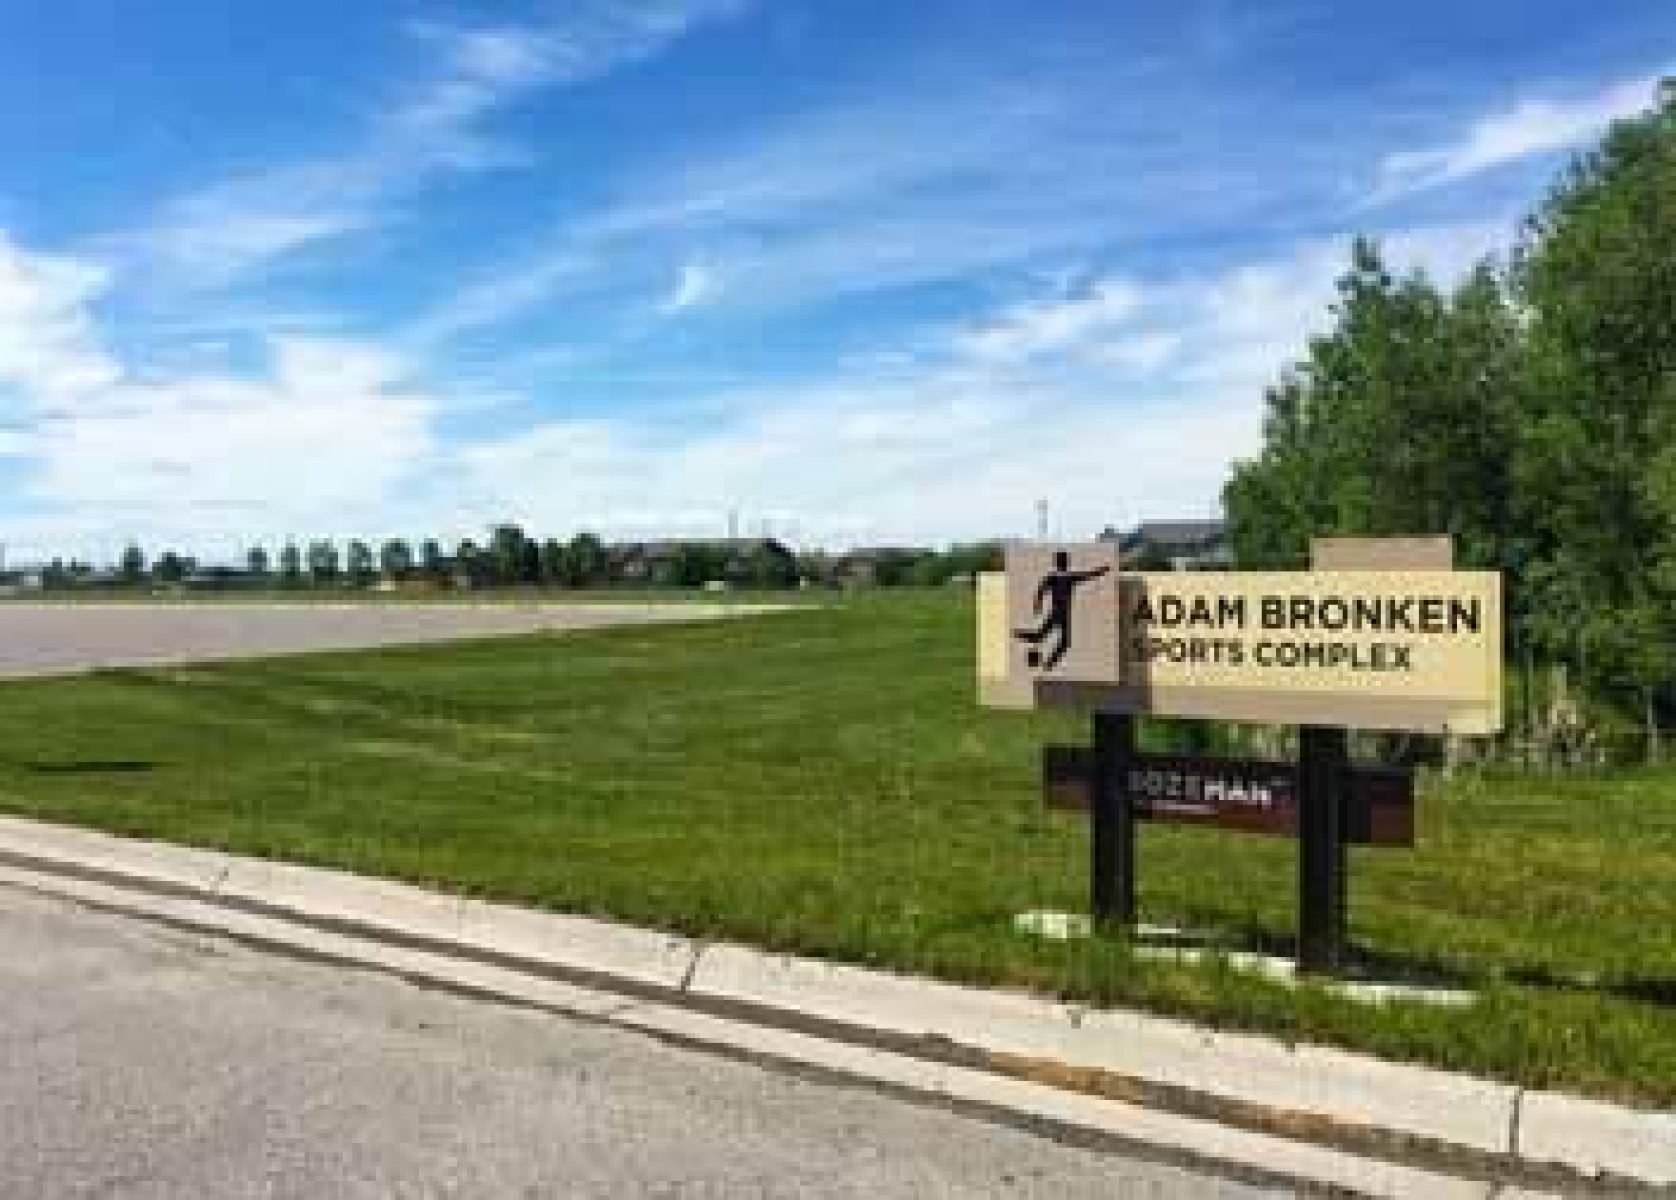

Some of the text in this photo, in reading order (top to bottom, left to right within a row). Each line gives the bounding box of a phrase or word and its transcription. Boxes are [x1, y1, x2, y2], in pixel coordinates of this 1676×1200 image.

[1132, 595, 1482, 633] ADAM BRONKEN
[1132, 637, 1411, 671] SPORTS COMPLEX
